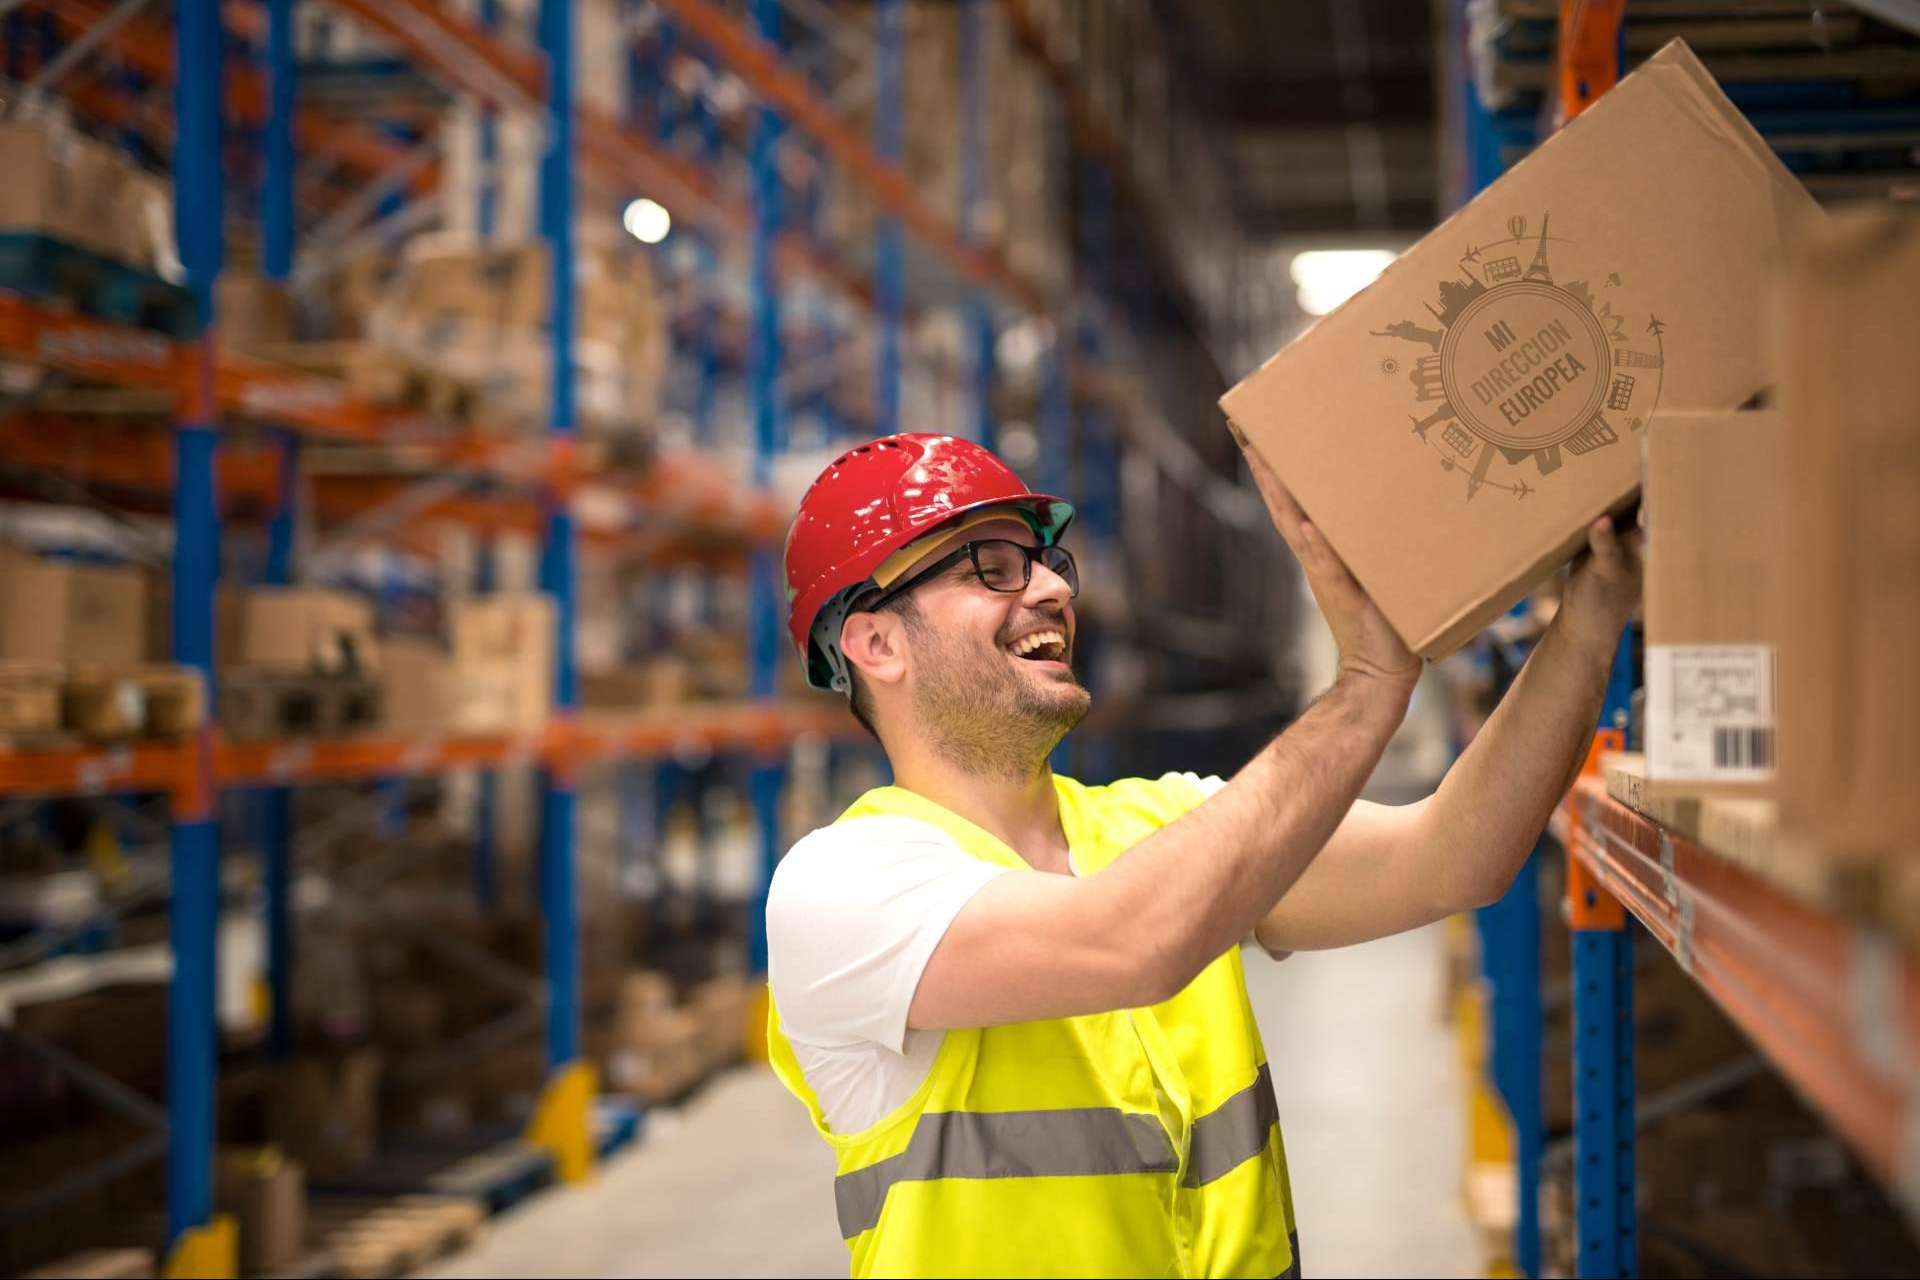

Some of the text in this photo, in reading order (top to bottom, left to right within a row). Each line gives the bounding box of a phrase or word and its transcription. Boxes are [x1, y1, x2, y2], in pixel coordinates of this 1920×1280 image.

[1471, 319, 1572, 405] DIRECCION
[1484, 320, 1516, 352] MI
[1498, 352, 1586, 426] EUROPEA
